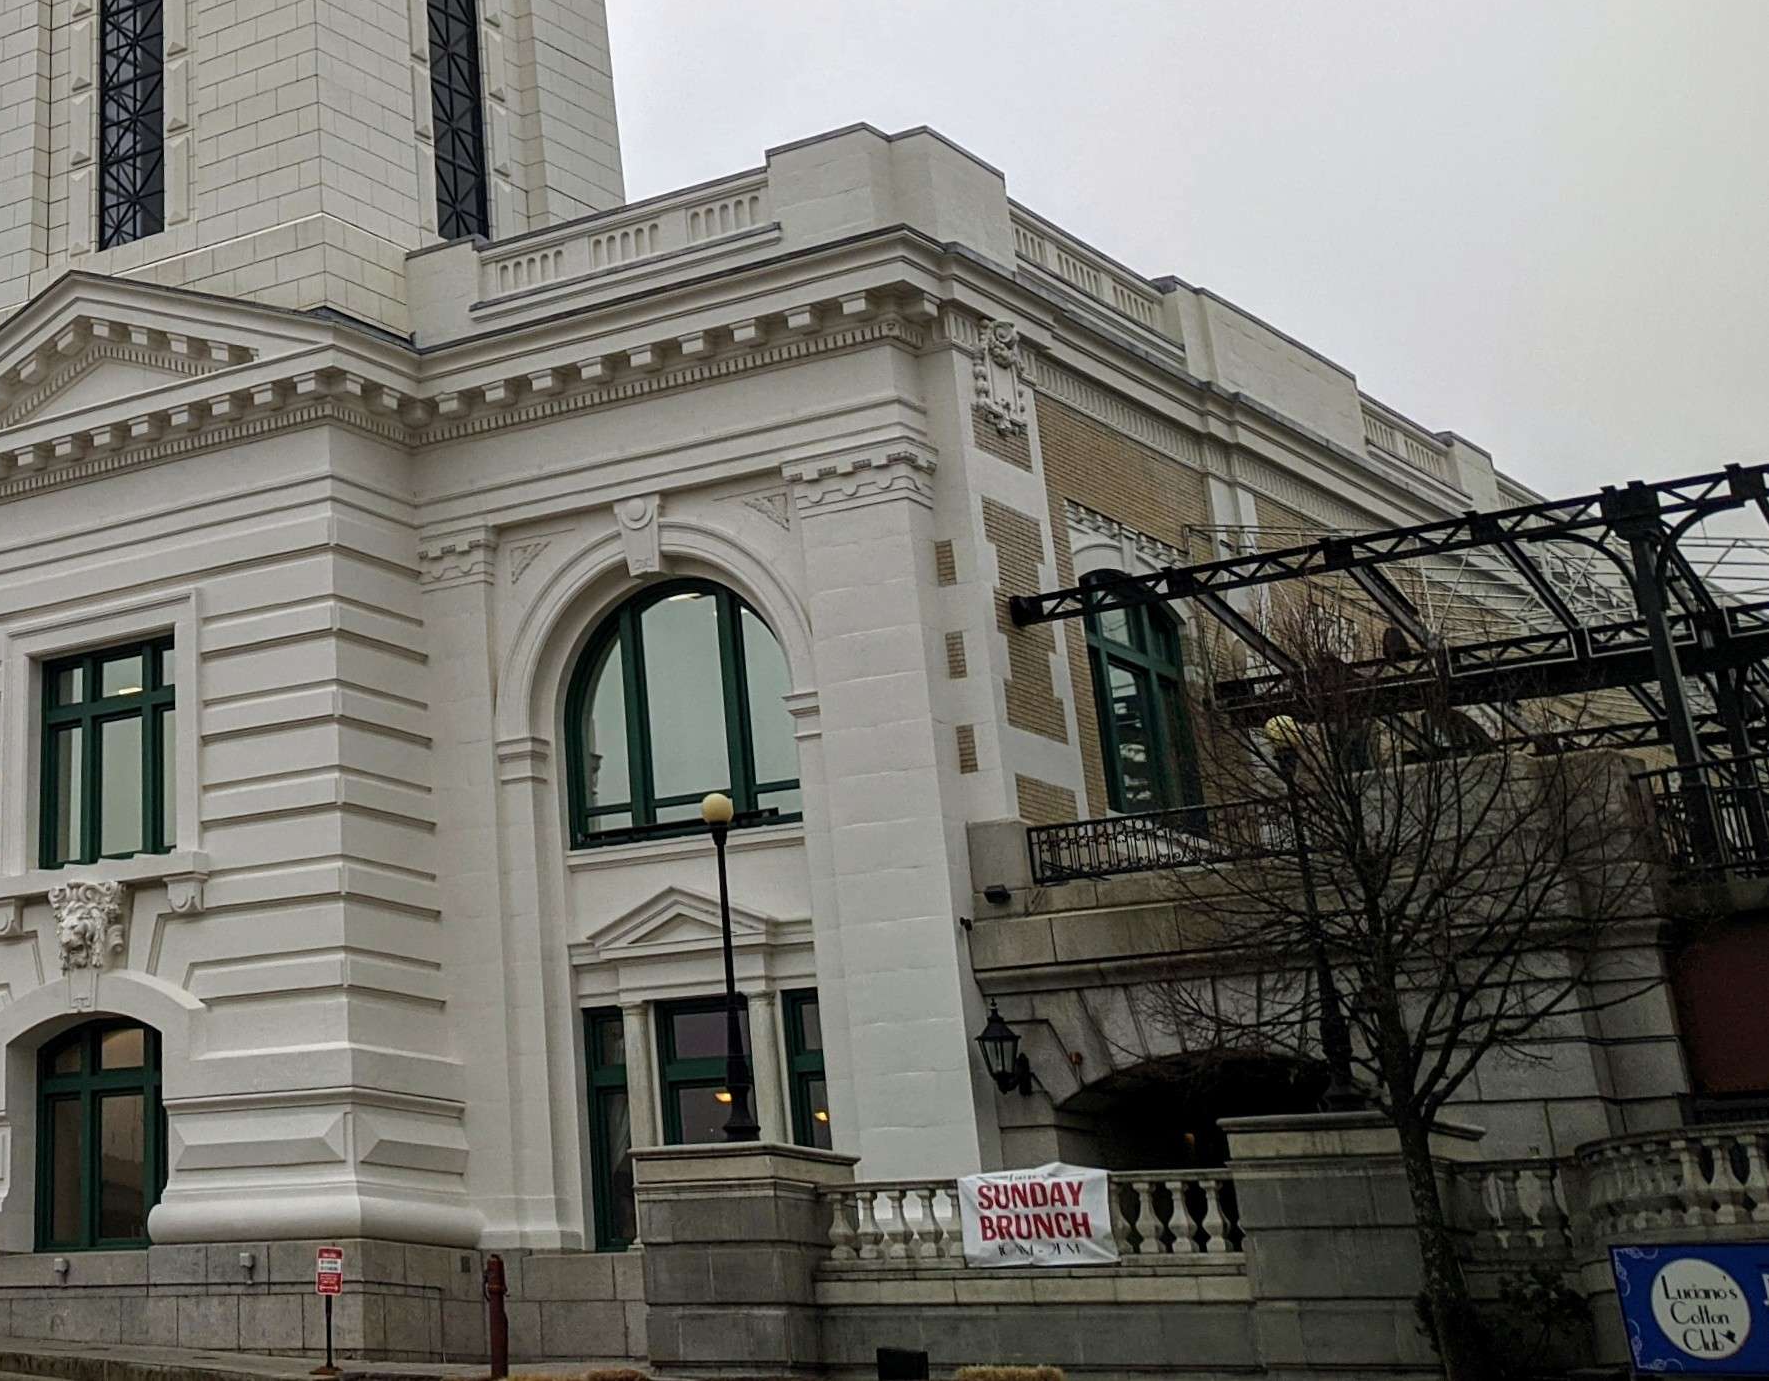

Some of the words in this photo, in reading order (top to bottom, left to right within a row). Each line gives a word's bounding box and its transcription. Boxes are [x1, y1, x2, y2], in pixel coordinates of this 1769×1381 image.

[977, 1181, 1084, 1210] SUNDAY
[979, 1212, 1092, 1241] BRUNCH
[1661, 1274, 1738, 1300] Luciano's
[1670, 1301, 1730, 1325] Cotton
[1683, 1329, 1725, 1352] Club
